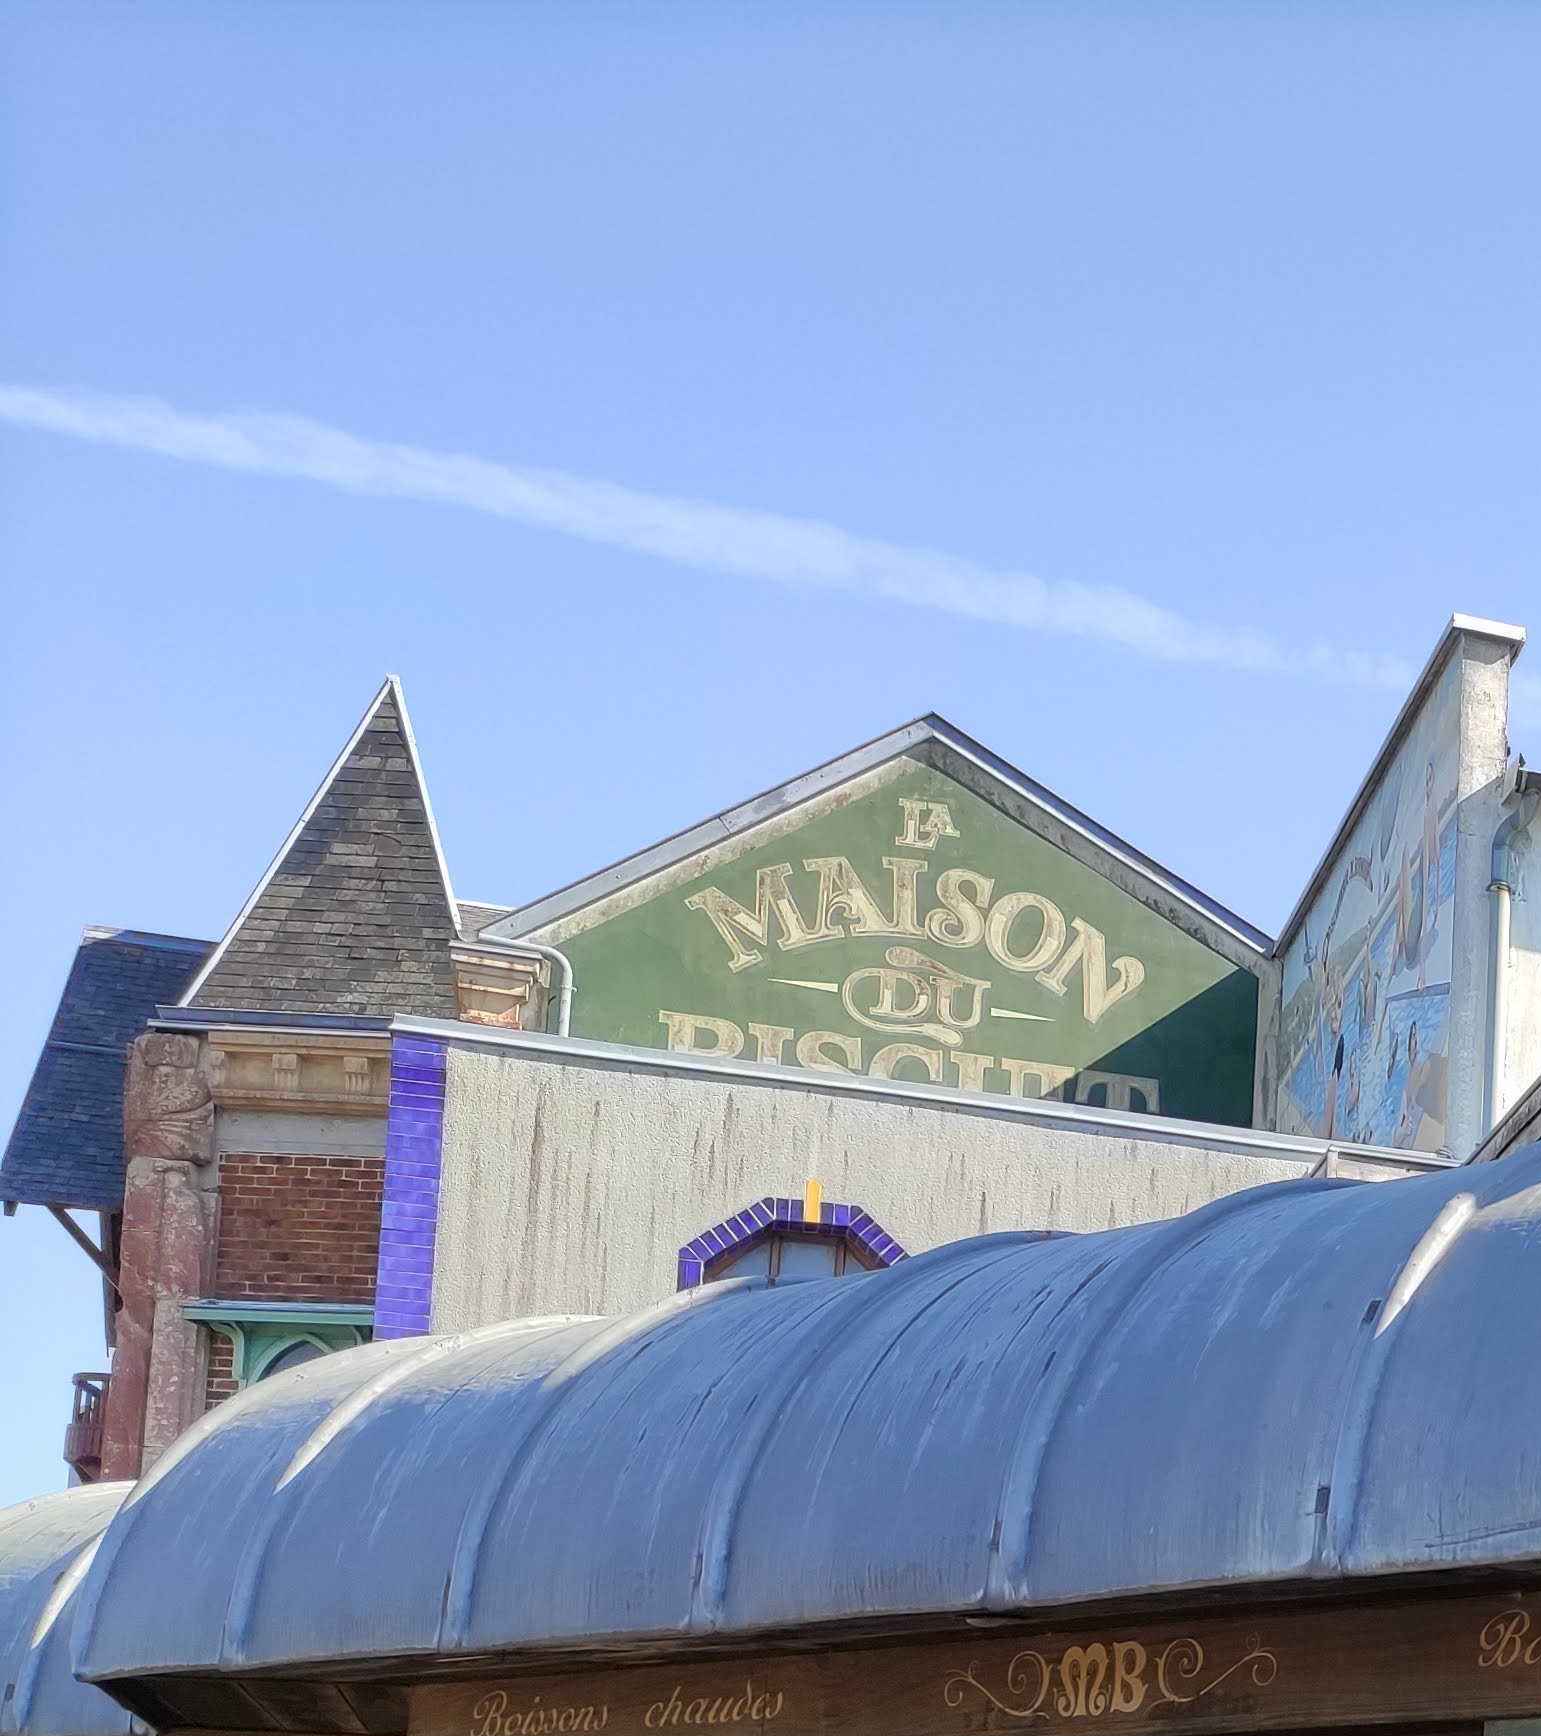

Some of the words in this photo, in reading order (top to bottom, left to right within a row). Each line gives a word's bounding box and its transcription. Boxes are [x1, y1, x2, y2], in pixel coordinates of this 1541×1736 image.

[895, 797, 961, 851] LA
[684, 855, 1146, 1026] MAISON
[844, 957, 991, 1042] DU
[644, 1679, 784, 1728] chaudes
[1055, 1641, 1150, 1718] MB
